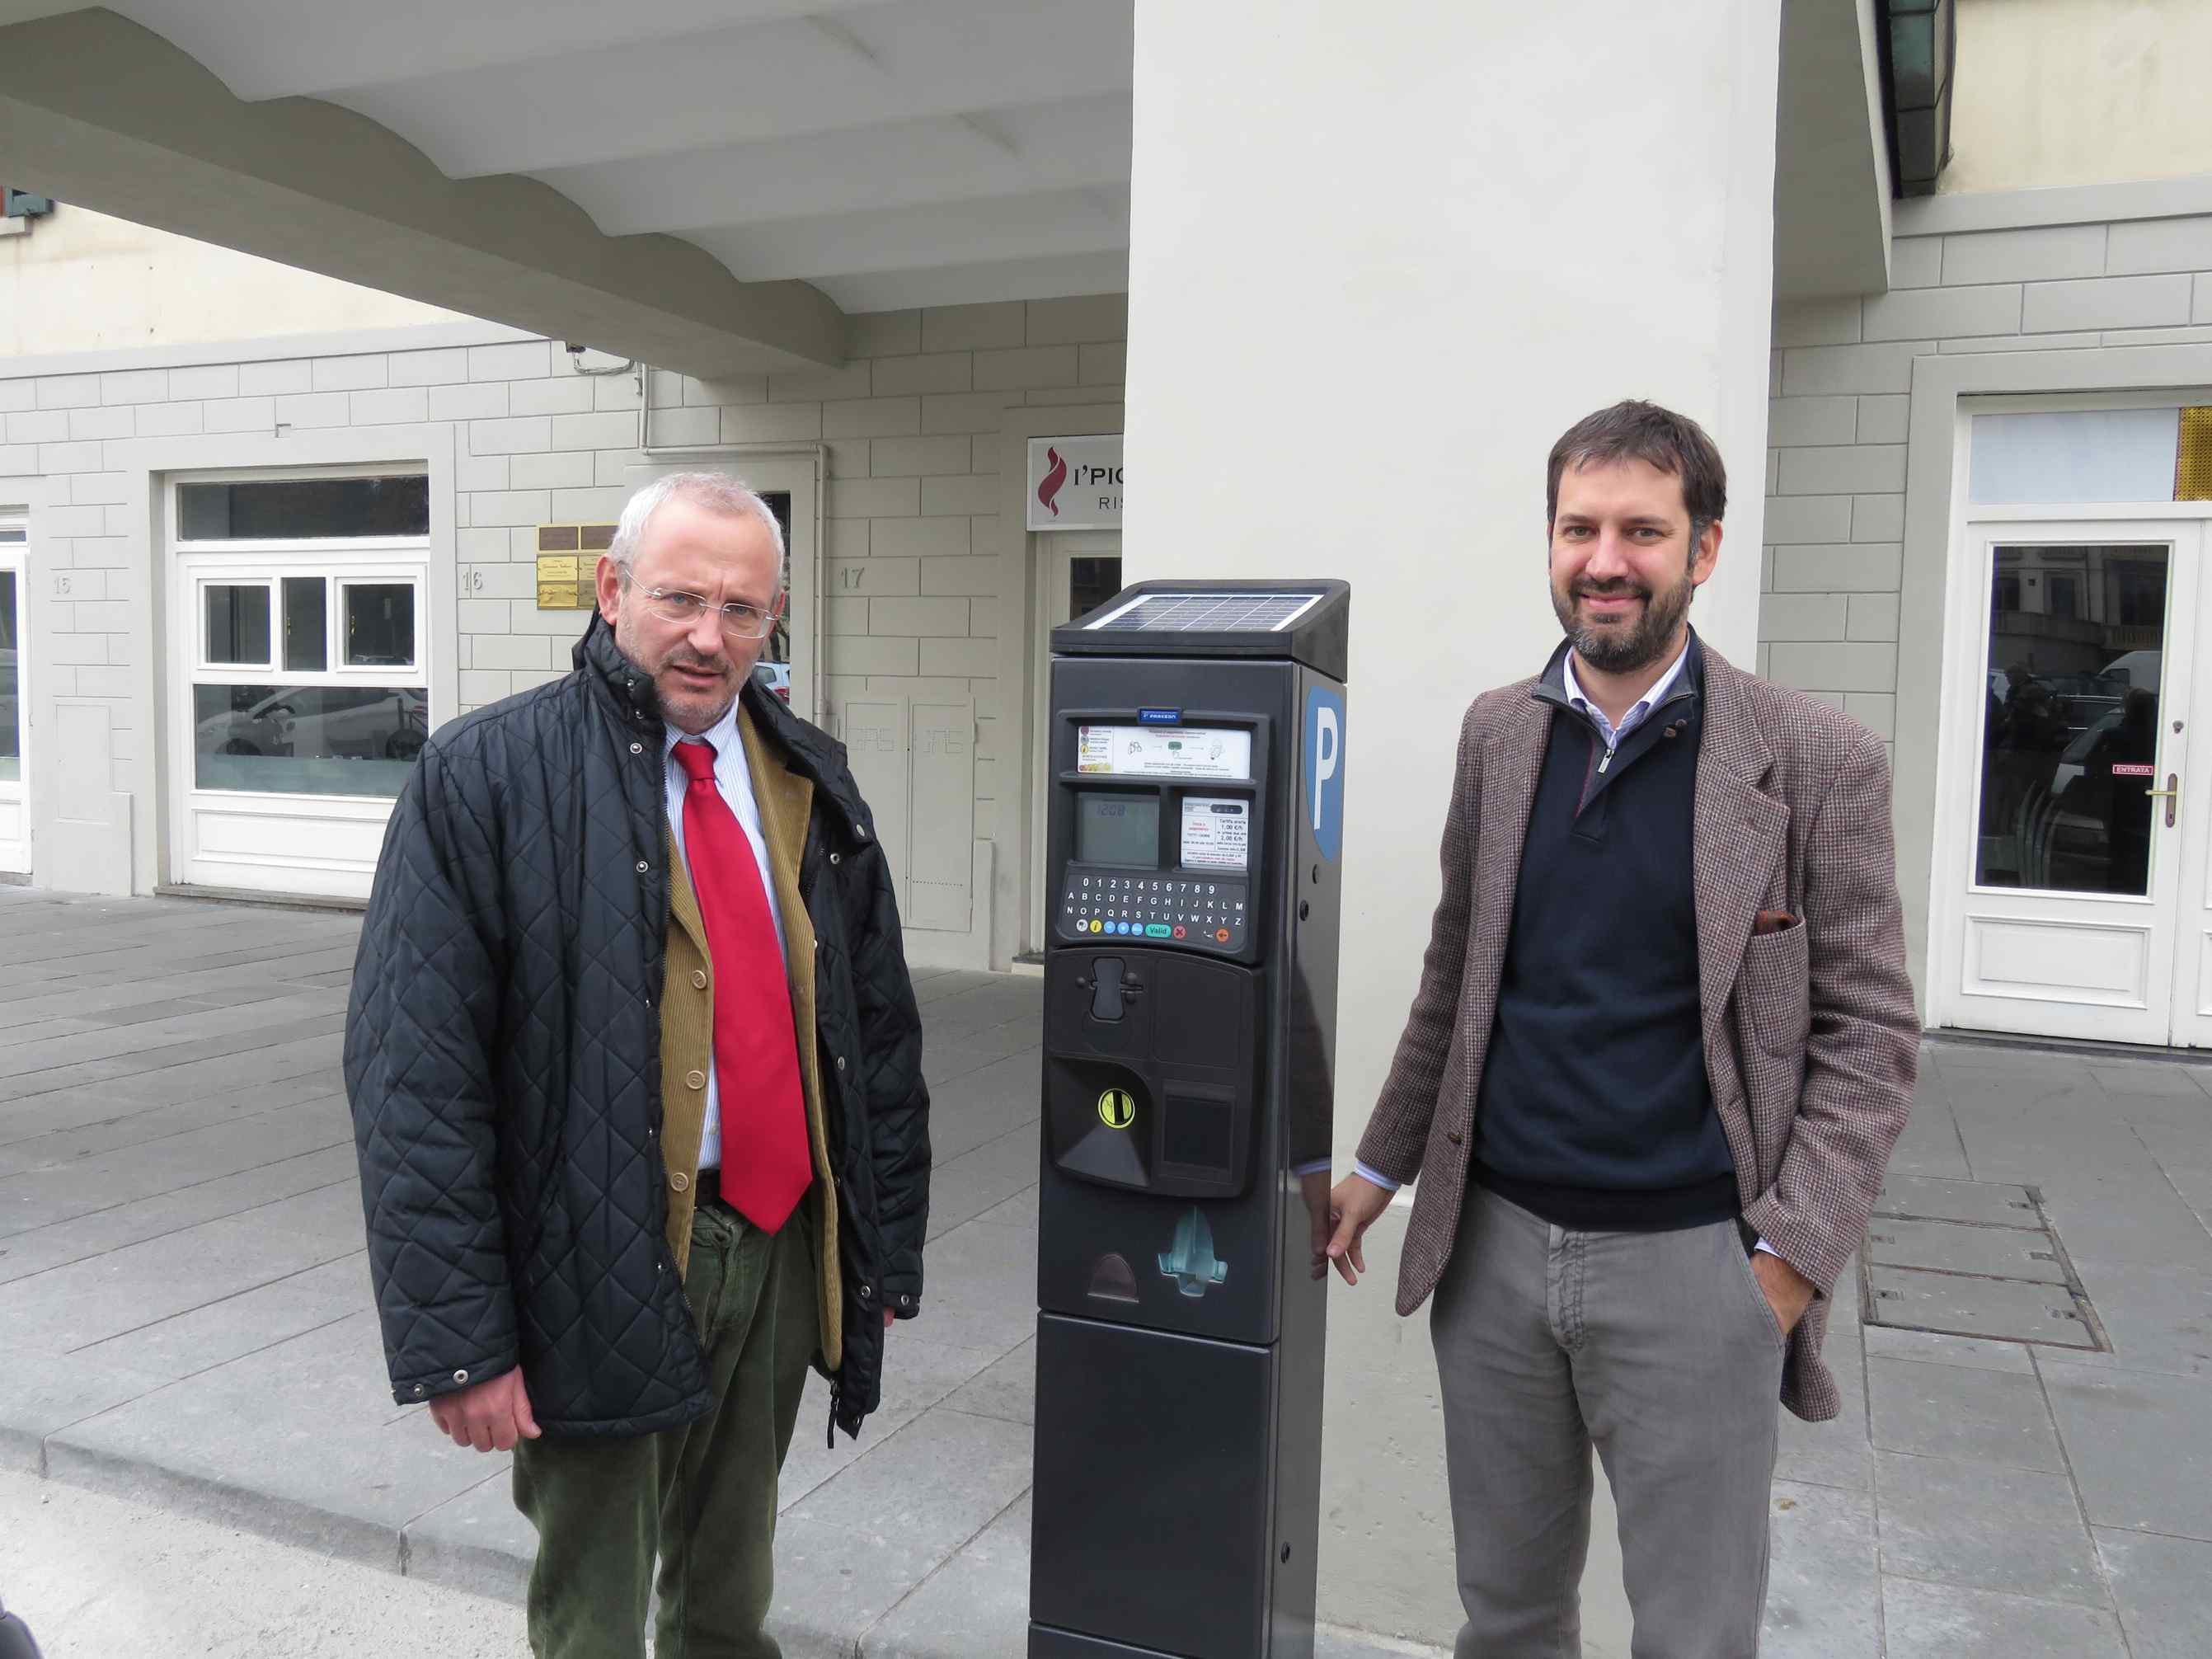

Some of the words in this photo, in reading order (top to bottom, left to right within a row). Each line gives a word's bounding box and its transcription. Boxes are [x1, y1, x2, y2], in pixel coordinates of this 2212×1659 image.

[462, 571, 484, 591] 16
[837, 566, 865, 589] 17
[1313, 706, 1339, 831] P
[1083, 877, 1089, 886] 0
[1110, 879, 1117, 889] 2
[1124, 880, 1130, 890] 3
[1138, 881, 1144, 891] 4
[1152, 881, 1158, 891] 5
[1166, 882, 1172, 892] 6
[1180, 883, 1187, 892] 7
[1194, 884, 1200, 894] 8
[1208, 885, 1215, 895] 9
[1068, 891, 1075, 900] A
[1082, 892, 1088, 900] B
[1095, 893, 1101, 901] C
[1109, 894, 1115, 902] D
[1123, 895, 1129, 904] E
[1137, 895, 1144, 904] F
[1150, 896, 1158, 905] G
[1164, 897, 1172, 906] H
[1207, 900, 1214, 909] K
[1235, 902, 1243, 911] M
[1067, 906, 1073, 914] N
[1080, 907, 1087, 915] O
[1094, 908, 1101, 916] P
[1107, 909, 1115, 918] Q
[1121, 909, 1128, 918] R
[1135, 910, 1142, 919] S
[1149, 911, 1156, 919] T
[1163, 912, 1170, 921] U
[1177, 913, 1185, 922] V
[1191, 914, 1200, 923] W
[1206, 915, 1213, 924] X
[1220, 916, 1228, 924] Y
[1234, 917, 1242, 926] Z
